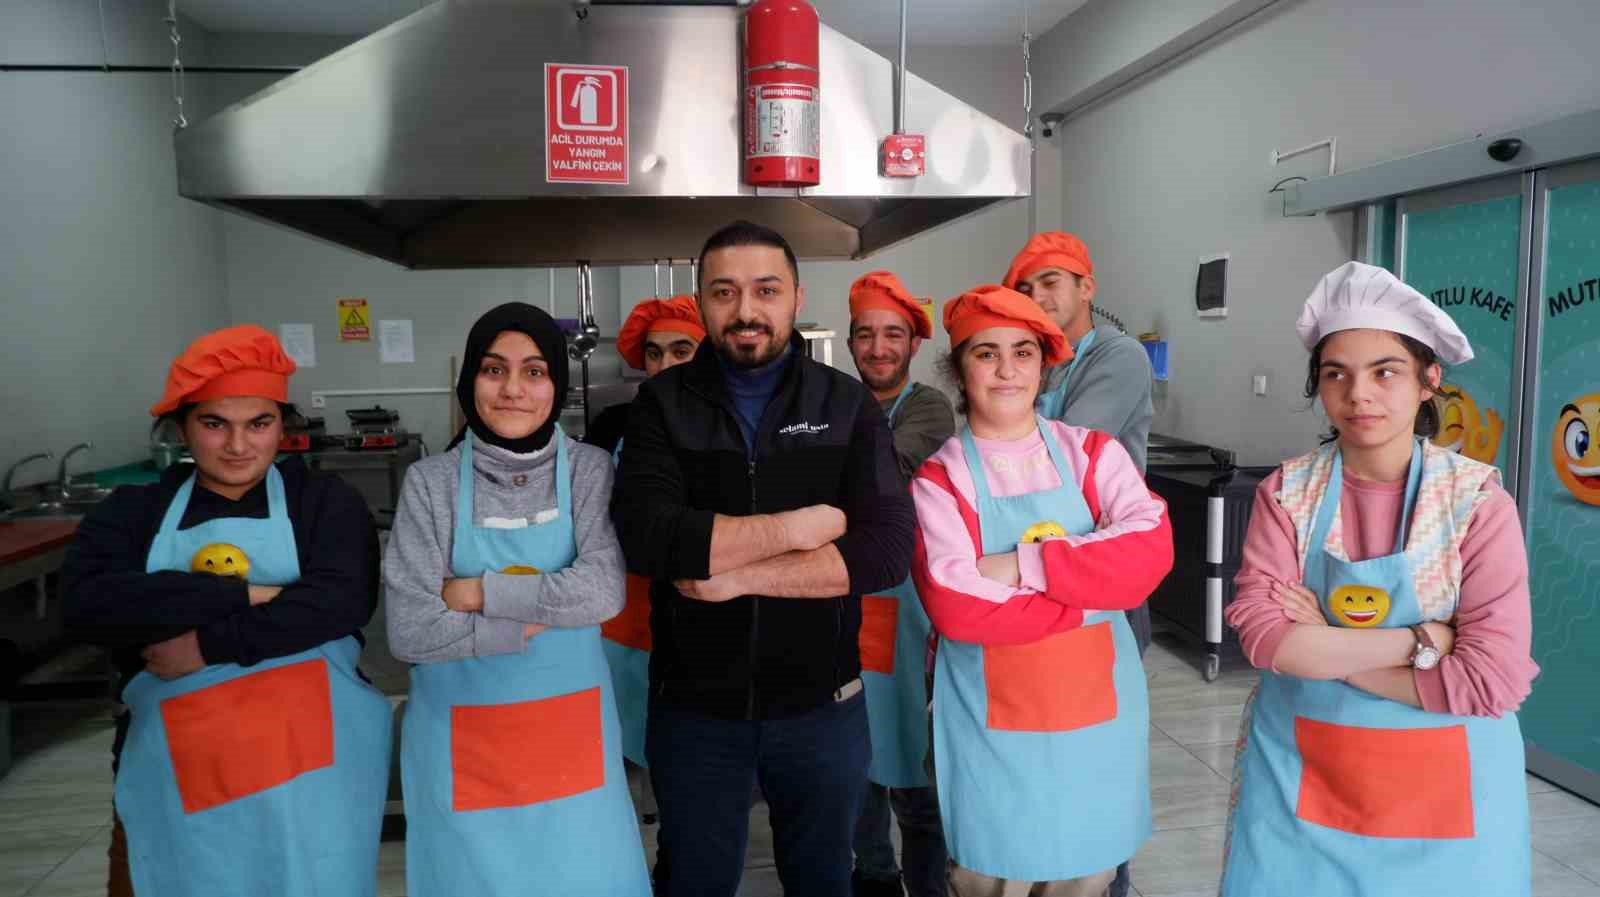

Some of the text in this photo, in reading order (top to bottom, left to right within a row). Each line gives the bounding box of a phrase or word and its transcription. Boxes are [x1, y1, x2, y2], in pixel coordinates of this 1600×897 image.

[551, 132, 624, 146] ACİL DURUMDA
[568, 147, 607, 159] YANGIN
[552, 159, 623, 172] VALFİNİ ÇEKİN
[1430, 286, 1514, 321] TLU KAFE
